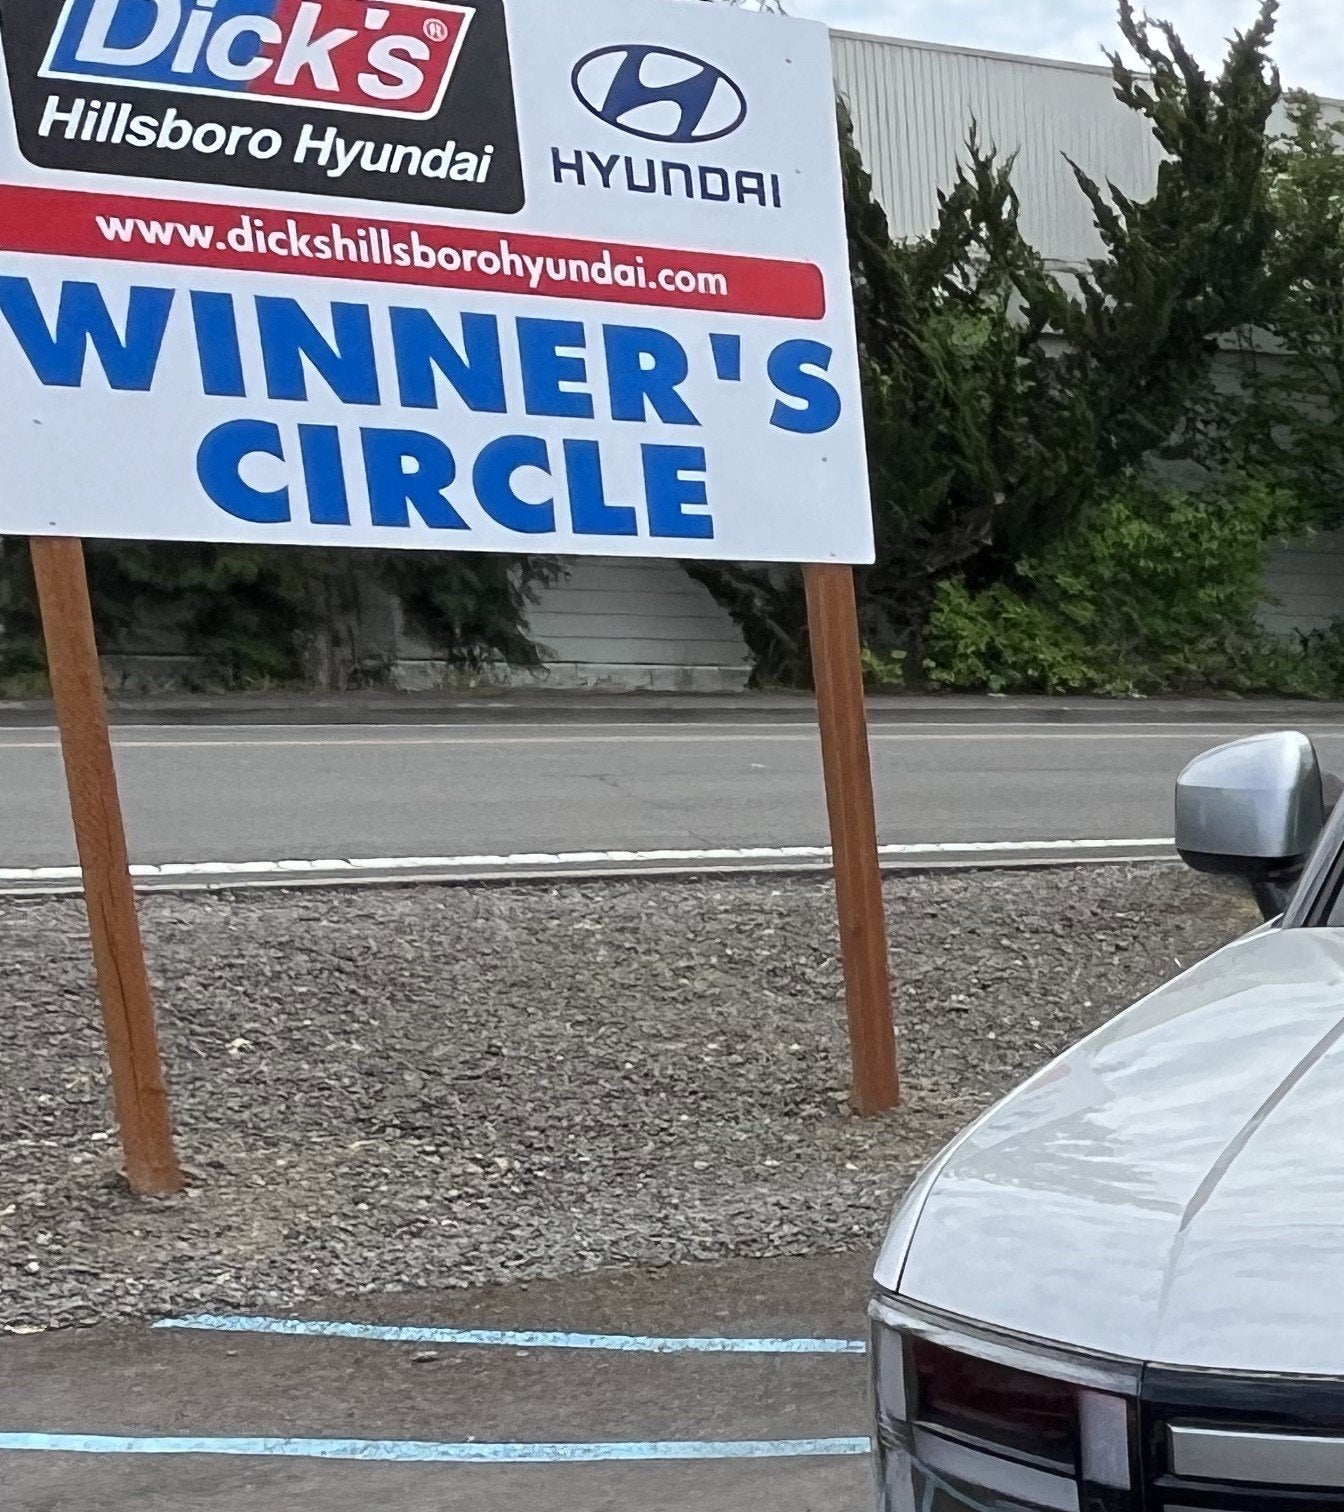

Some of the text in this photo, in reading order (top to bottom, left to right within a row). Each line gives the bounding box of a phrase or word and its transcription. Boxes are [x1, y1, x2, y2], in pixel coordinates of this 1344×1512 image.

[37, 95, 495, 183] Hillsboro Hyundai
[551, 146, 782, 208] HYUNDAI
[95, 214, 729, 297] www.dickshillsborohyundai.com
[0, 276, 842, 434] WINNER'S
[196, 418, 715, 540] CIRCLE
